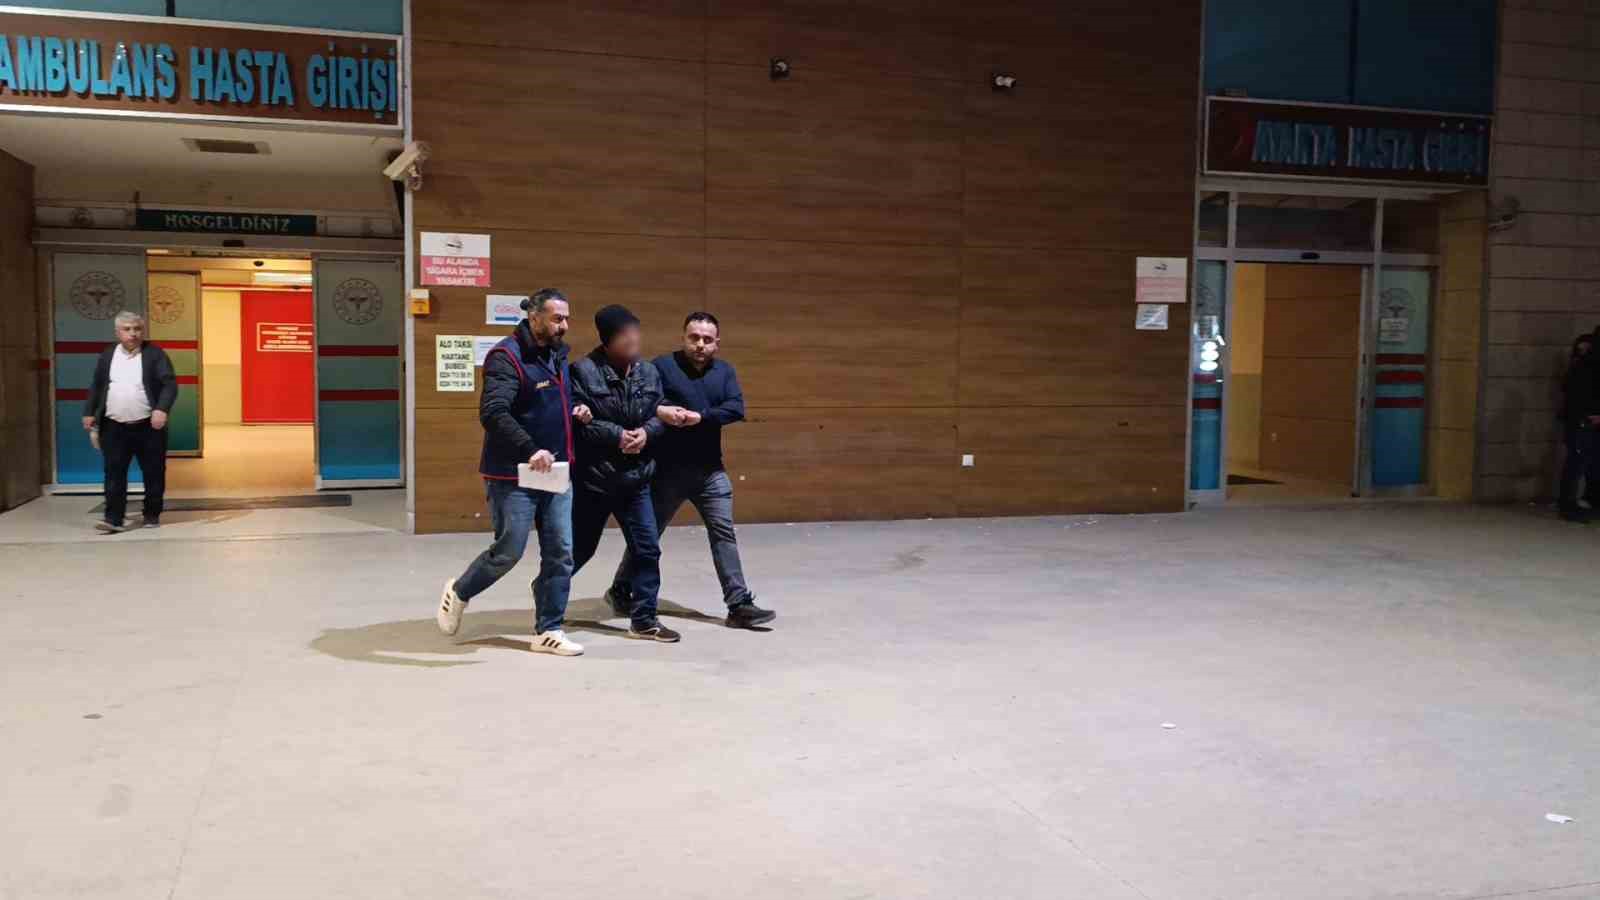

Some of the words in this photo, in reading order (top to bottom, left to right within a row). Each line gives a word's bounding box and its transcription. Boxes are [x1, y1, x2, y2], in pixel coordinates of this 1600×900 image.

[0, 34, 176, 99] AMBULANS
[190, 47, 294, 107] HASTA
[307, 41, 396, 119] GİRİŞİ
